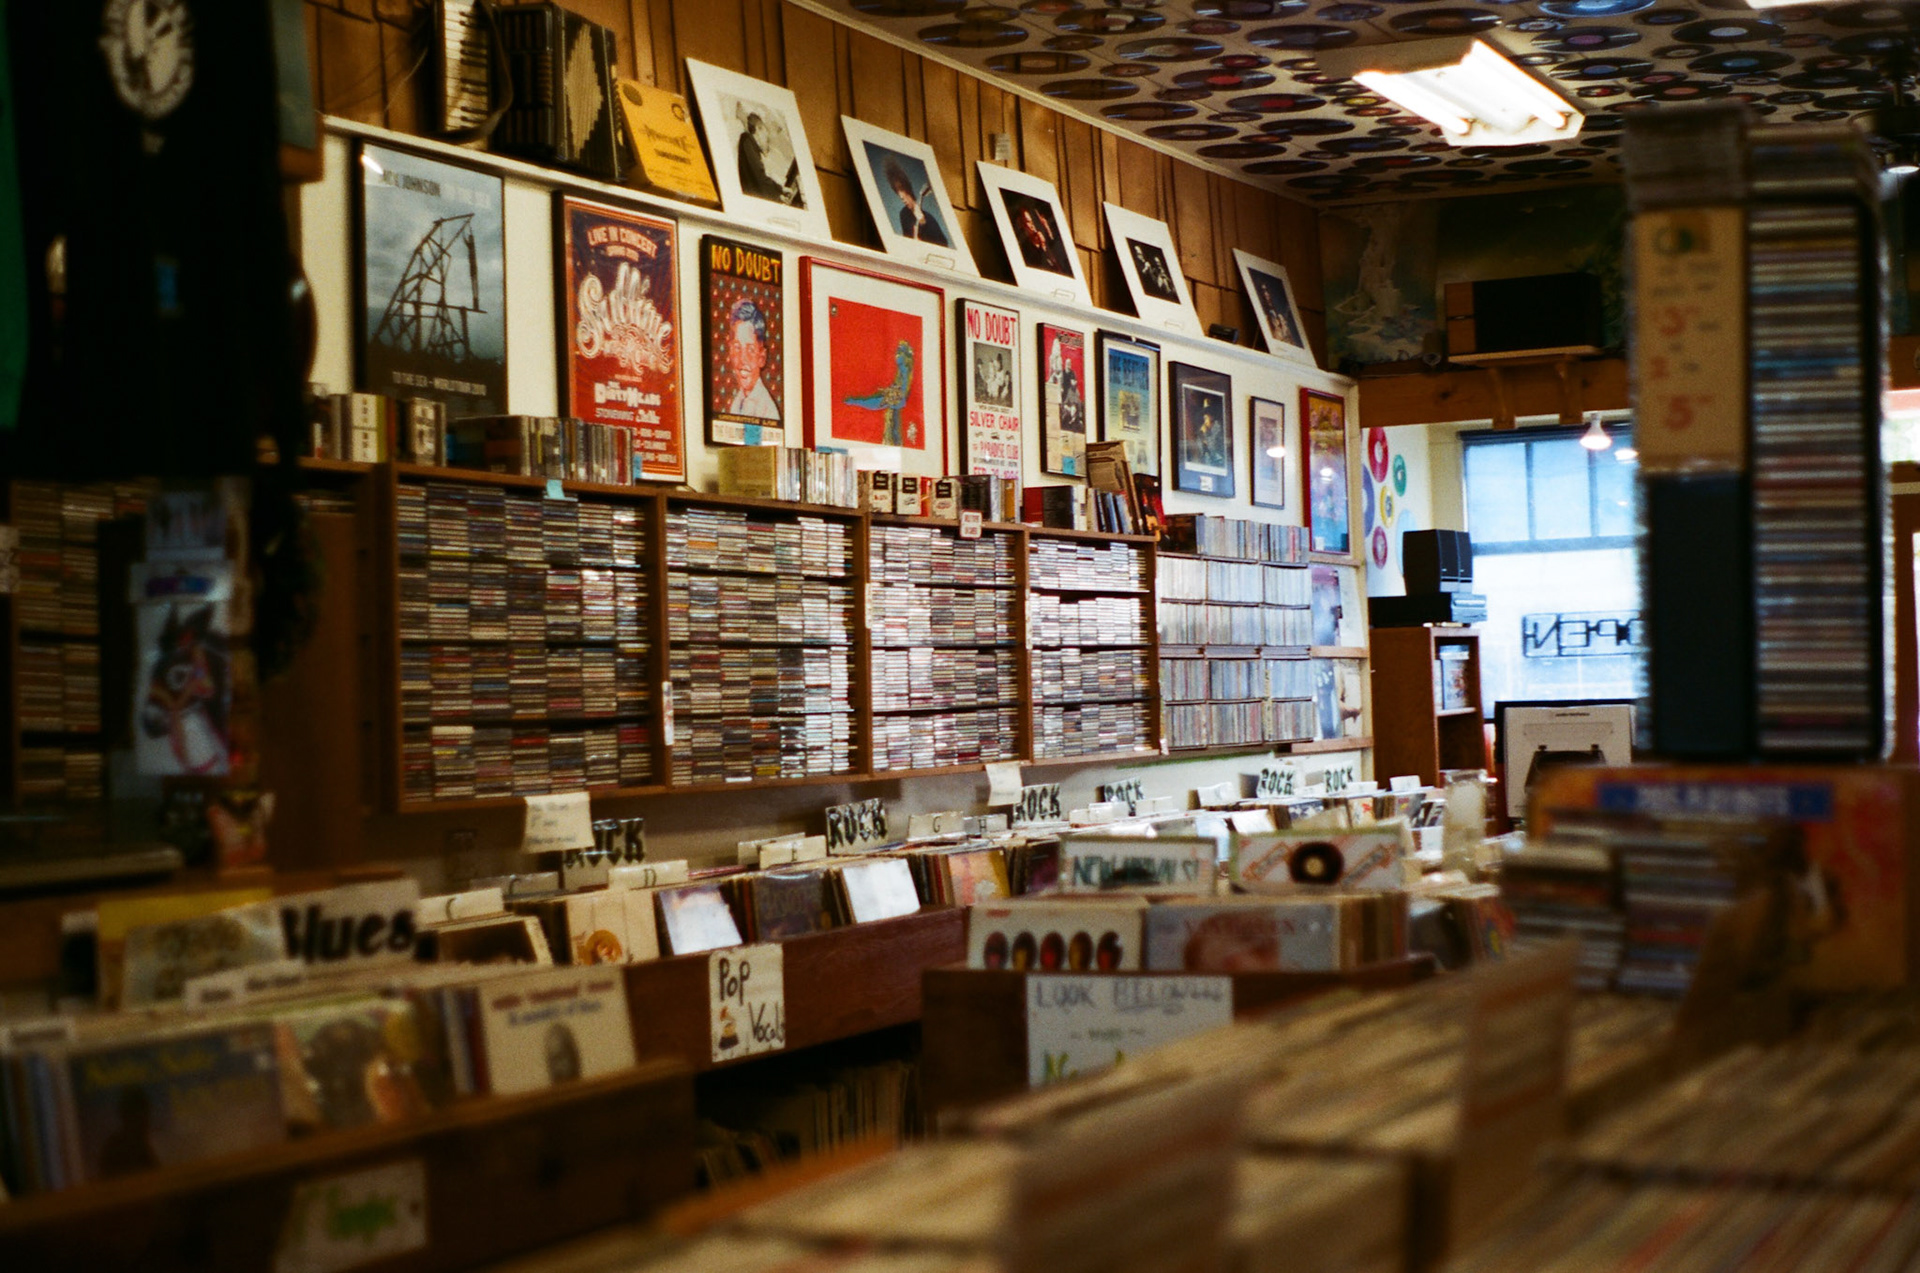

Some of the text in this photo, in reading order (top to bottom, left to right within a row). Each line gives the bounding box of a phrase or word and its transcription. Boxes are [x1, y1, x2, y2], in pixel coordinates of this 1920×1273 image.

[587, 226, 609, 247] LIVE
[619, 228, 658, 259] CONCERT
[711, 244, 781, 284] NO DOUBT
[967, 307, 981, 340] NO
[985, 311, 1016, 347] DOUBT
[970, 411, 1019, 432] SILVER CHAIR
[1261, 767, 1294, 795] ROCK
[1325, 767, 1354, 793] ROCK
[827, 799, 888, 849] ROCK
[643, 868, 657, 887] D
